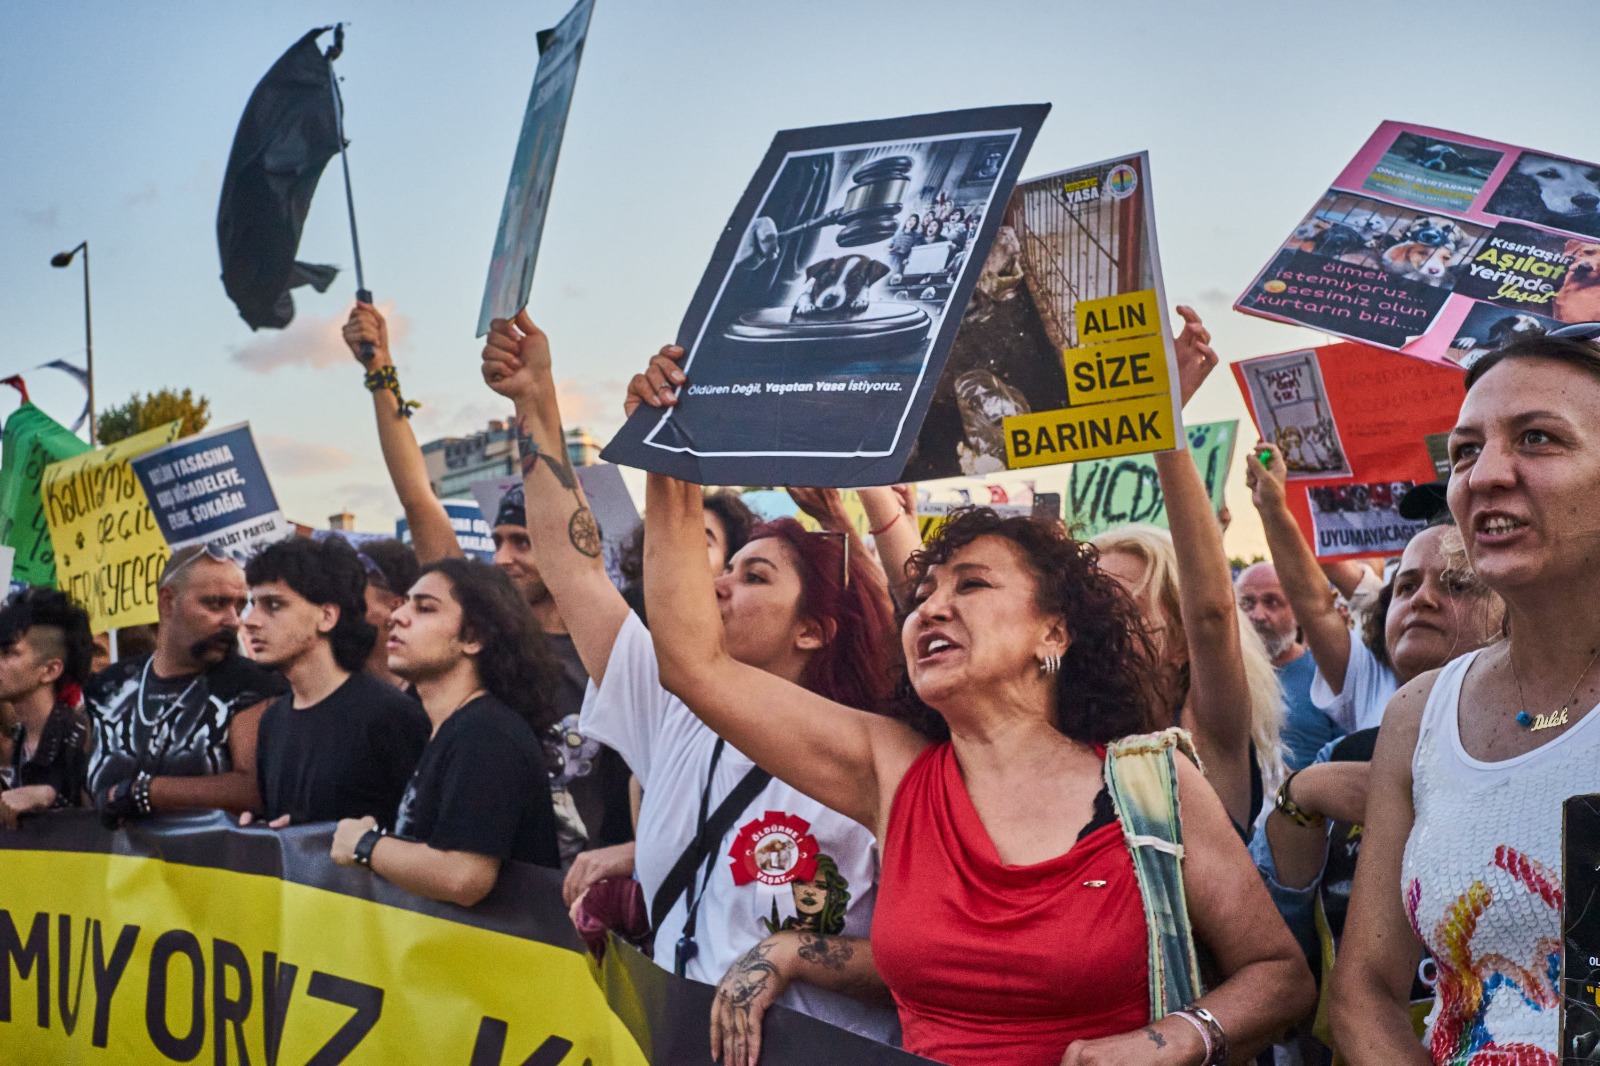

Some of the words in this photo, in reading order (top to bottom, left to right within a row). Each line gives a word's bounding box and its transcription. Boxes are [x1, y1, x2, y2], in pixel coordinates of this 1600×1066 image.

[1066, 186, 1100, 204] YASA
[1476, 247, 1567, 280] Aşılat
[1490, 237, 1574, 265] Kısırlaştır
[1322, 262, 1389, 282] ölmek
[1469, 263, 1555, 293] Yerinde
[1287, 284, 1370, 307] sesimiz
[1378, 301, 1427, 318] olun
[1083, 302, 1147, 336] ALIN
[687, 384, 730, 396] Öldüren
[765, 381, 814, 395] Yaşatan
[816, 381, 847, 392] Yasa
[848, 379, 903, 394] İstiyoruz.
[1074, 352, 1155, 393] SİZE
[1010, 410, 1163, 459] BARINAK
[172, 444, 235, 478] YASASINA
[191, 490, 247, 524] SOKAĞA!
[1530, 707, 1569, 732] Dilek
